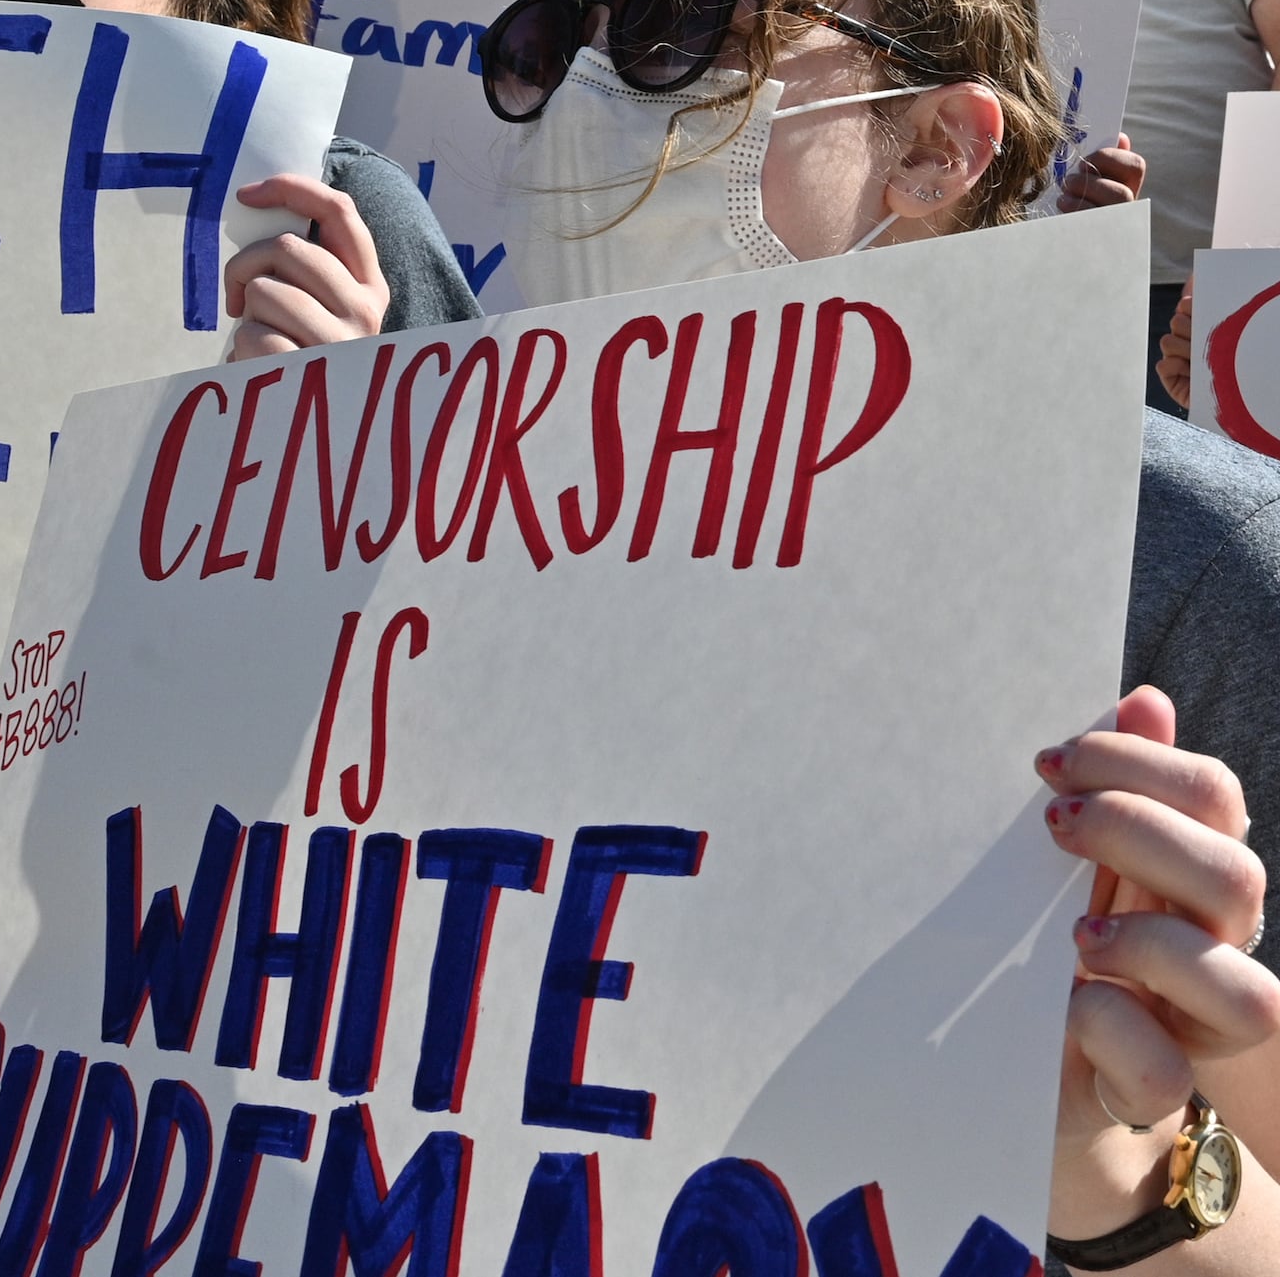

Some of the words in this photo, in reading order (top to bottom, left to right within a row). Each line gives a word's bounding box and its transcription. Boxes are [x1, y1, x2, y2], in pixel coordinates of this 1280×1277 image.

[139, 297, 911, 581] CENSORSHIP
[3, 629, 66, 701] STOP
[304, 606, 429, 824] IS
[103, 804, 708, 1140] WHITE
